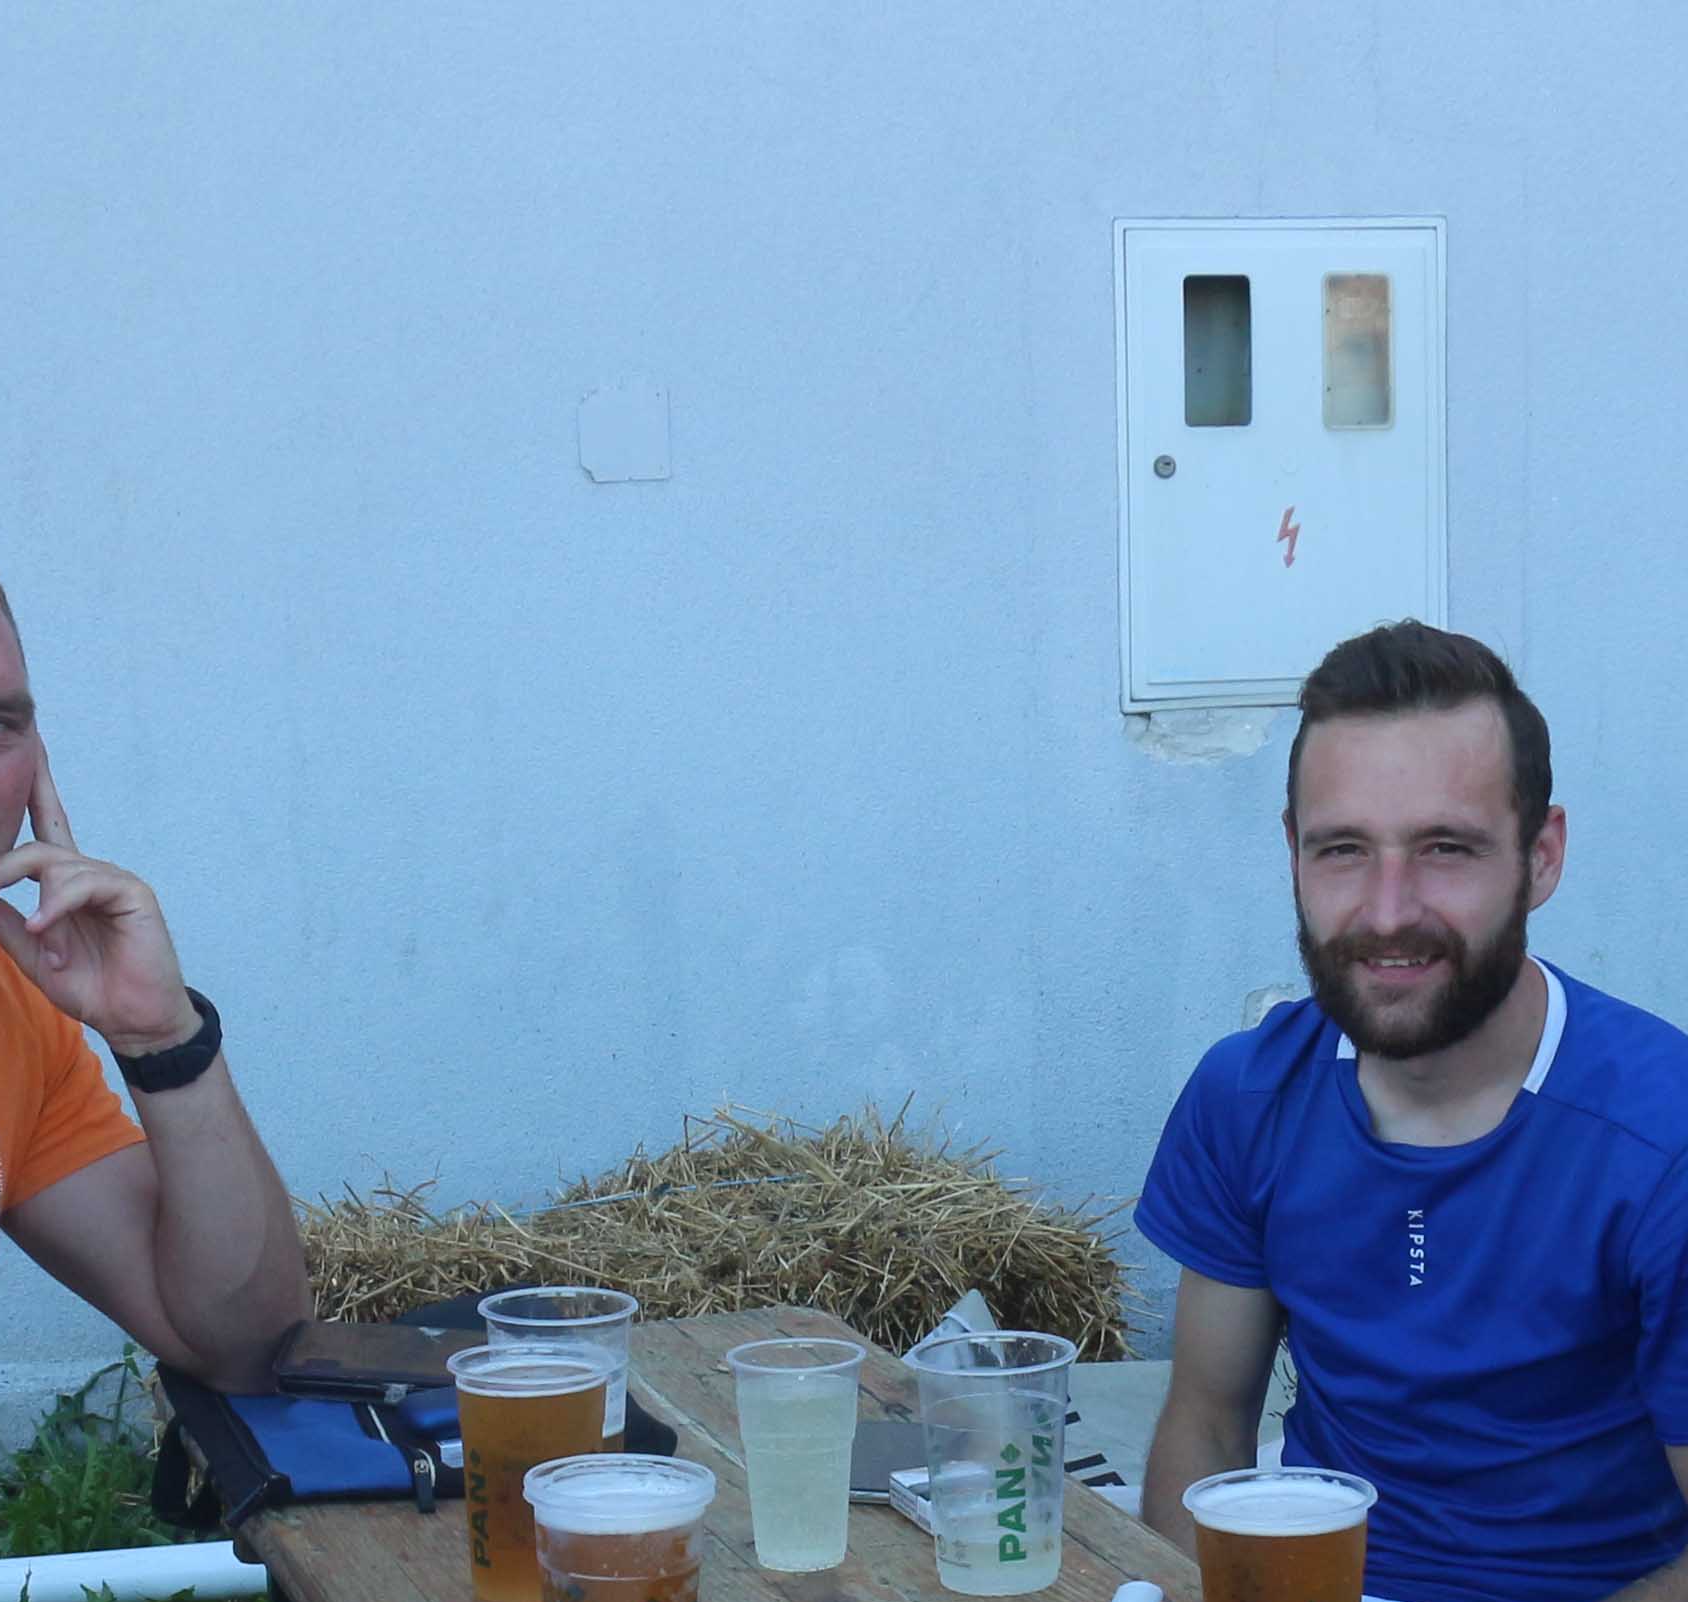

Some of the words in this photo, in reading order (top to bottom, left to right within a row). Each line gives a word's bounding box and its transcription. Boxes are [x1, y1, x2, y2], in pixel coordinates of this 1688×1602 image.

[1408, 1209, 1424, 1286] KIPSTA
[468, 1472, 492, 1569] PAN
[996, 1467, 1027, 1563] PAN
